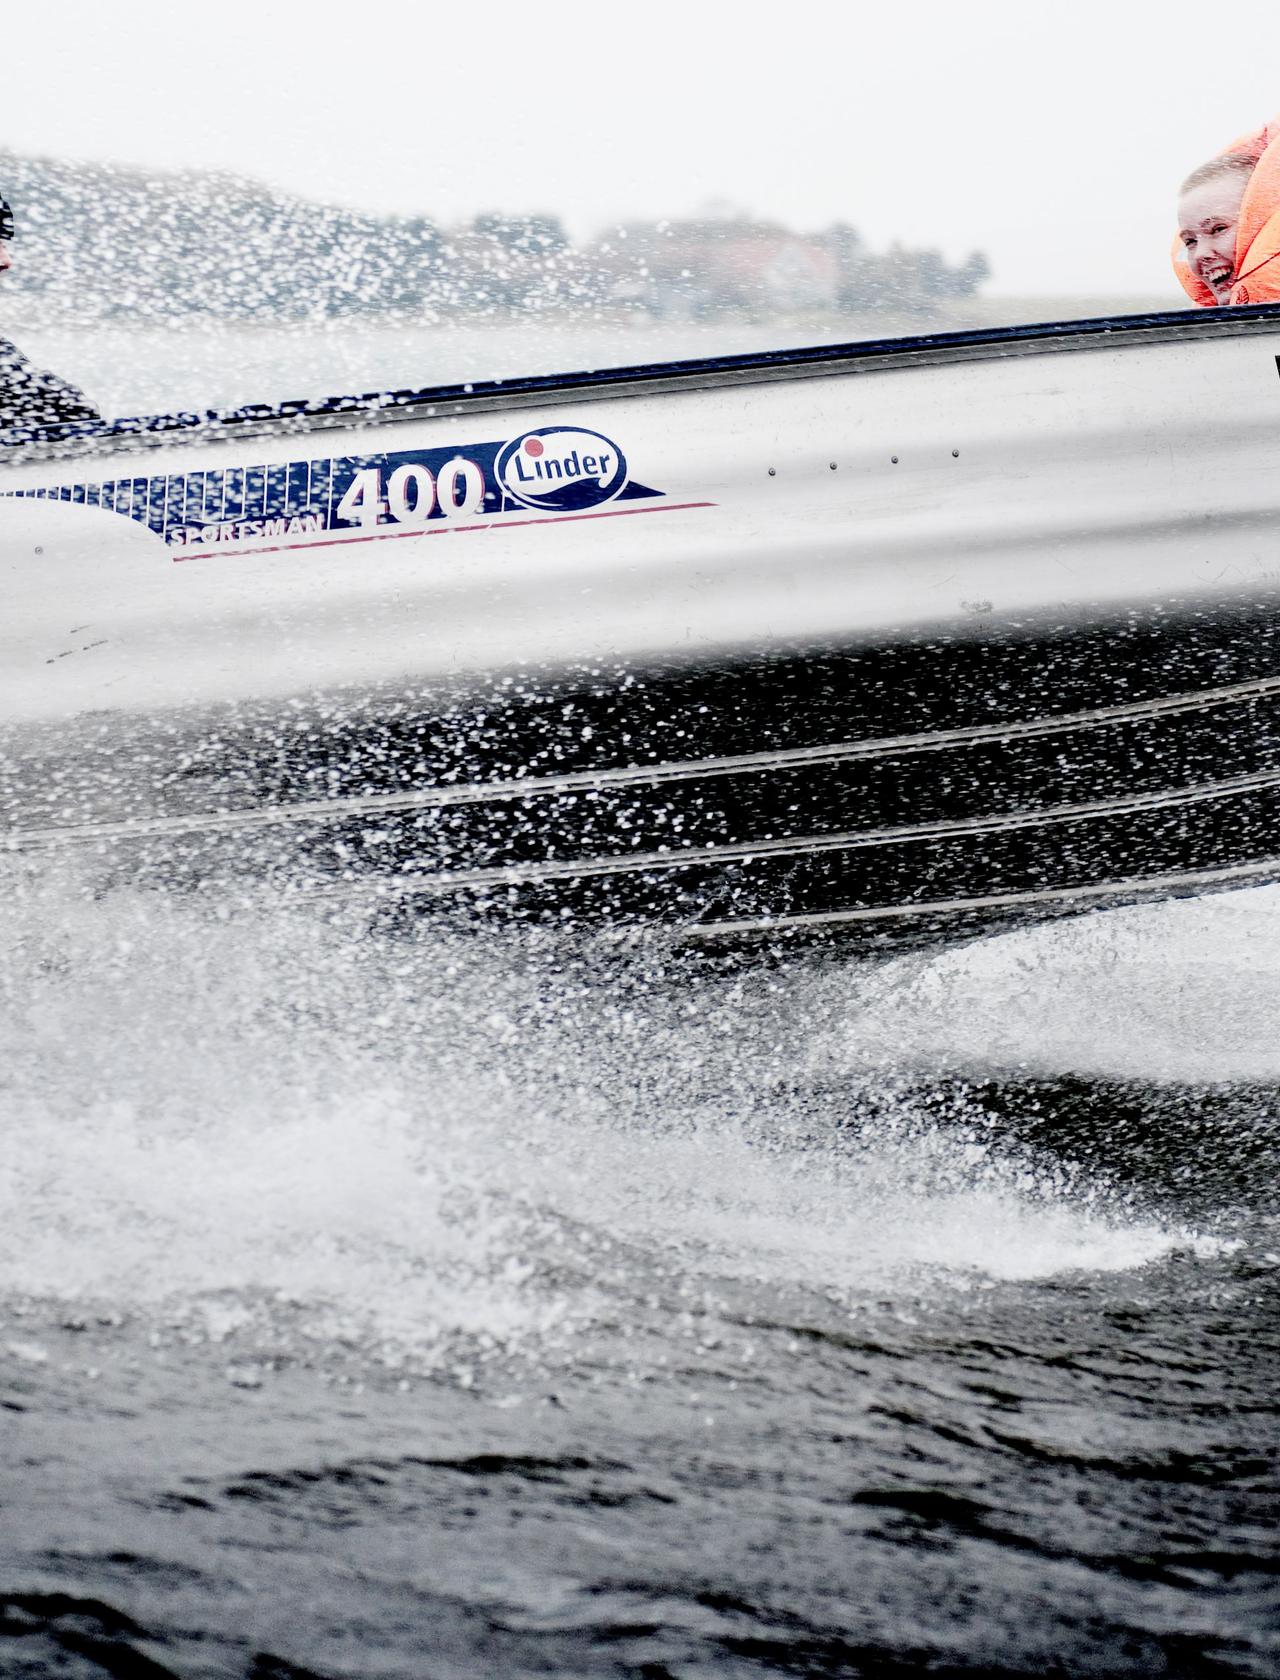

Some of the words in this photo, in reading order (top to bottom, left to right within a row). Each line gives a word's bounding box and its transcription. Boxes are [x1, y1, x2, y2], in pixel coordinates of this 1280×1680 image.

[514, 438, 610, 482] Linder
[170, 514, 325, 546] SPORTSMAN
[336, 459, 486, 527] 400
